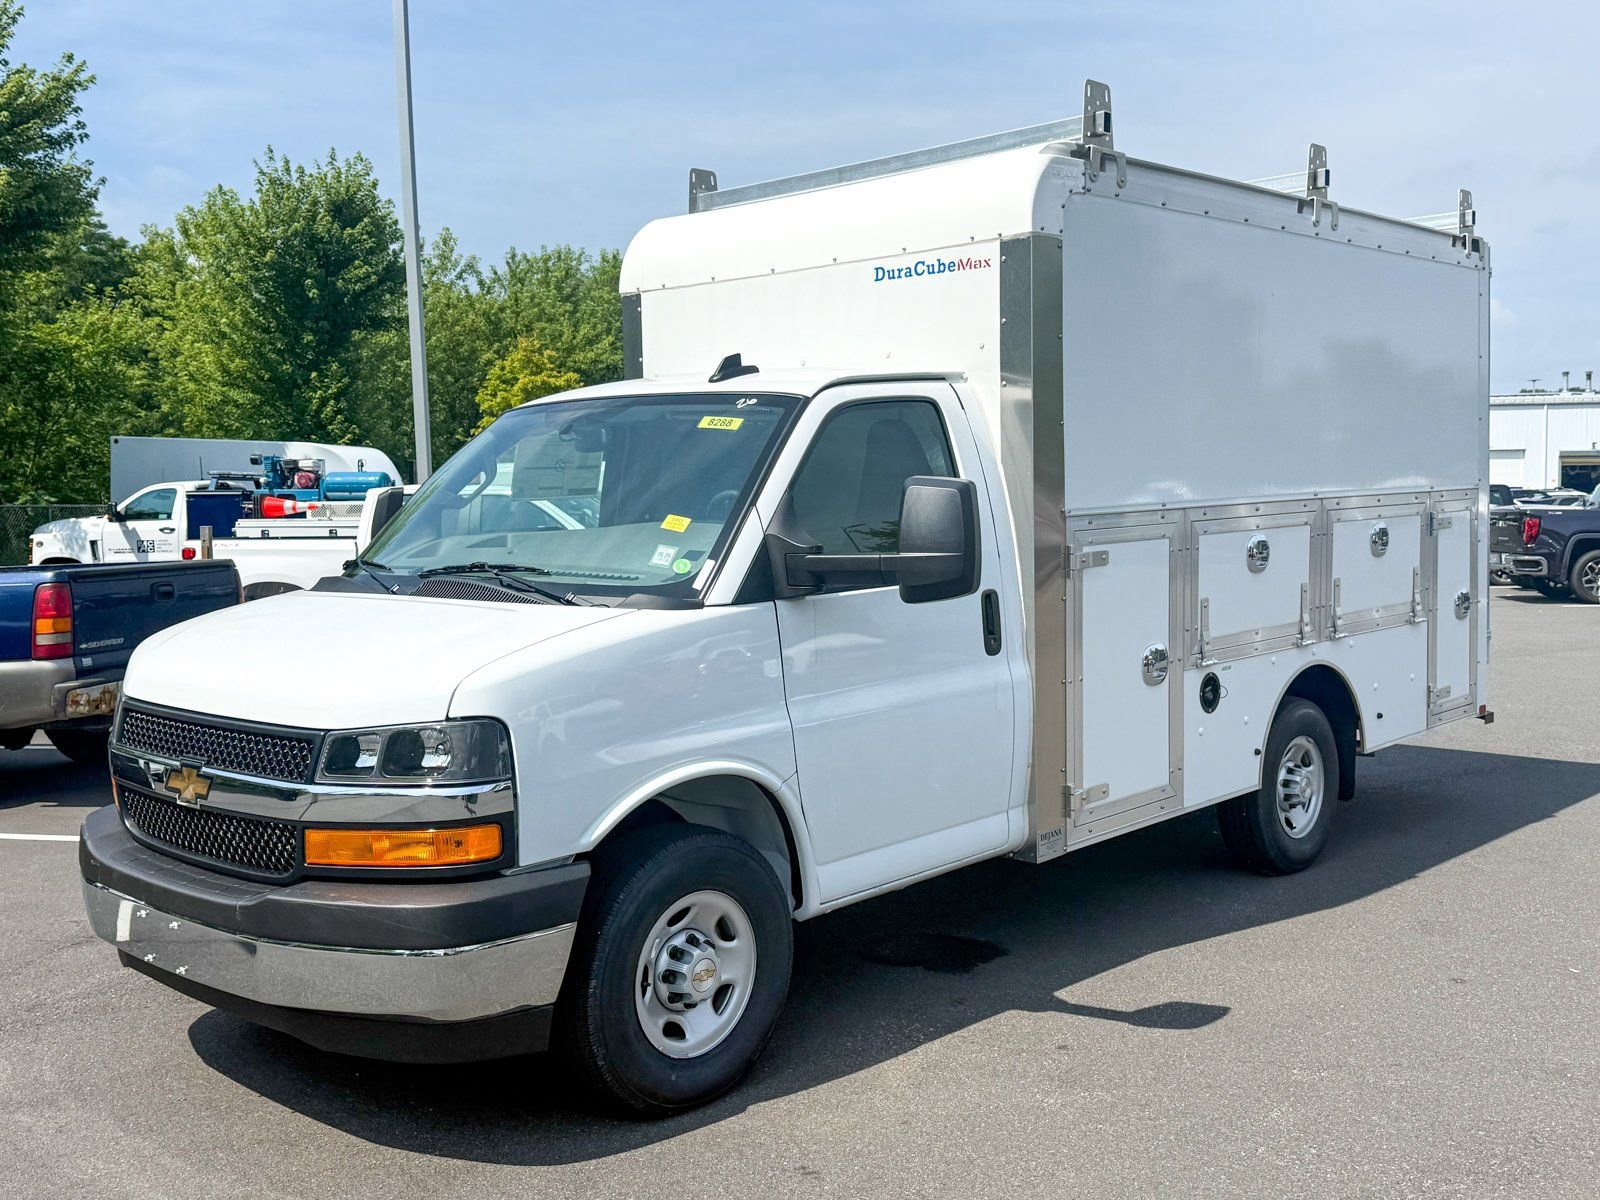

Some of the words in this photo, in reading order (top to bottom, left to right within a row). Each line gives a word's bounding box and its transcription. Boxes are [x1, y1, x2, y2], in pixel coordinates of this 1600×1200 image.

[874, 258, 991, 282] DuraCubeMax
[707, 418, 734, 427] 8288
[1040, 828, 1062, 842] DEJANA
